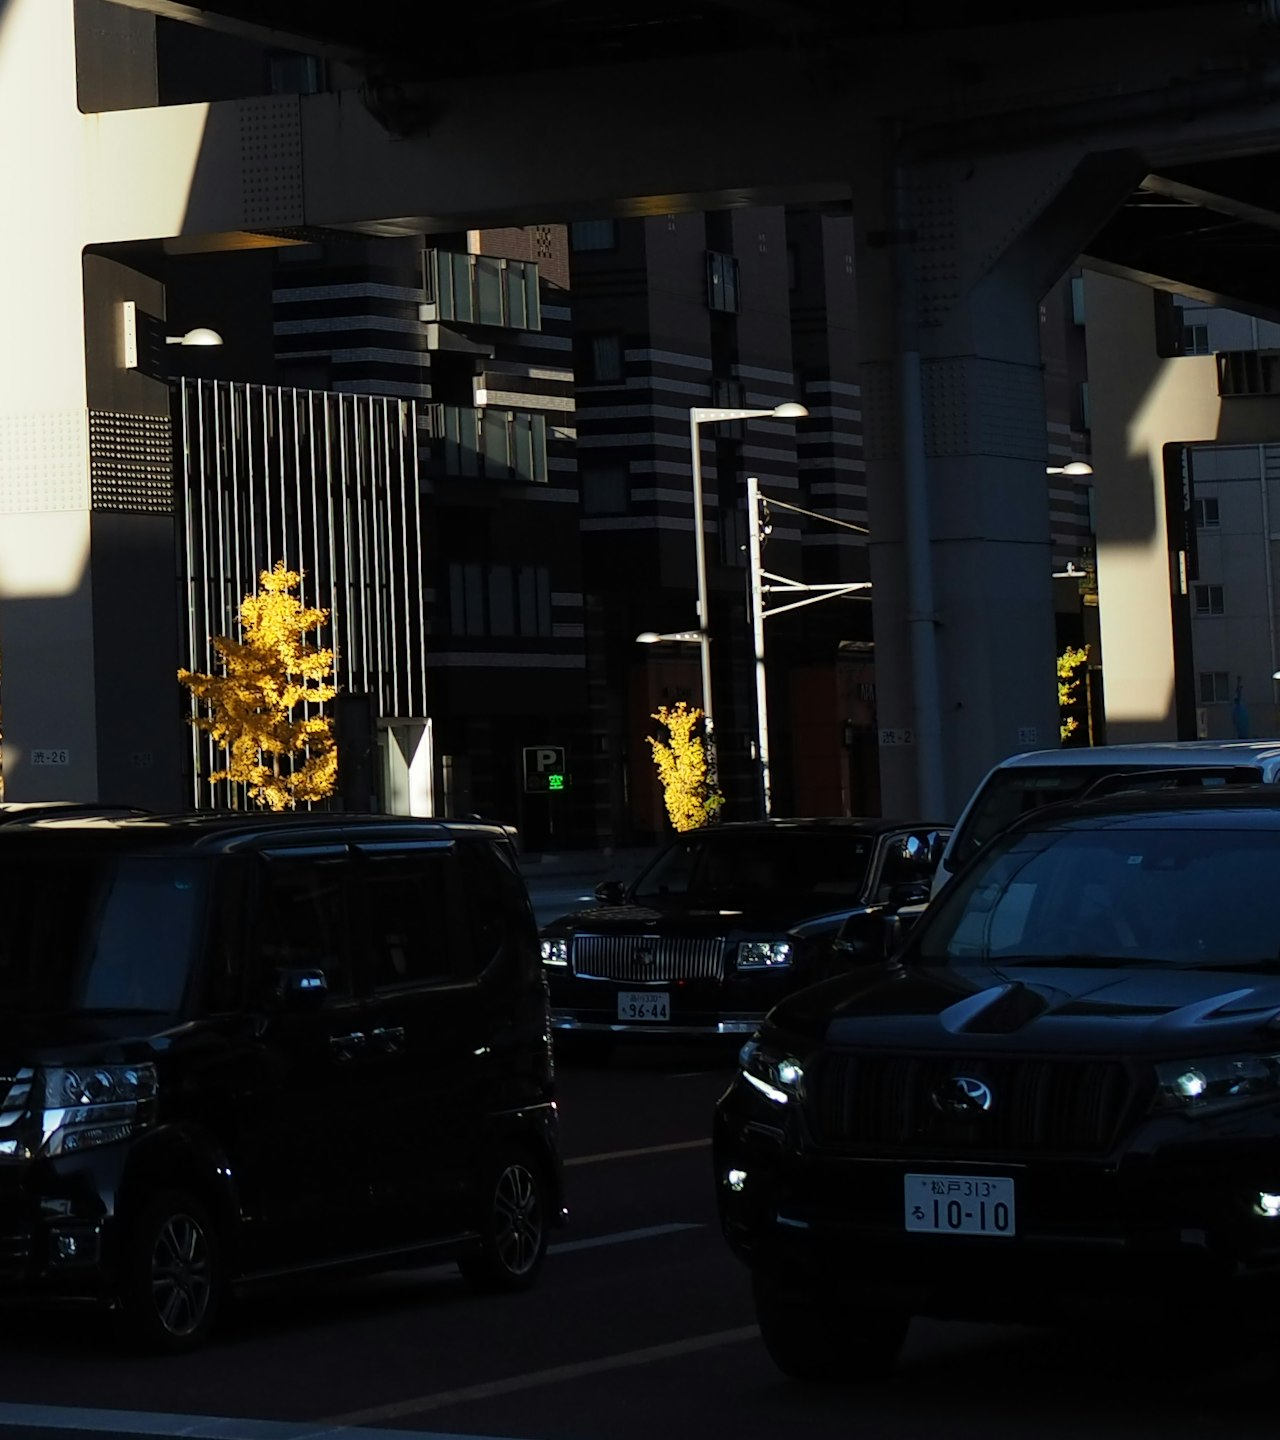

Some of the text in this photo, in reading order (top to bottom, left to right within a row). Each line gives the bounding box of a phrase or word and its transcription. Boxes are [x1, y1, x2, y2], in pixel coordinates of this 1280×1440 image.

[536, 749, 558, 772] P
[629, 1003, 667, 1019] 96-44
[911, 1199, 1009, 1231] る 10-10
